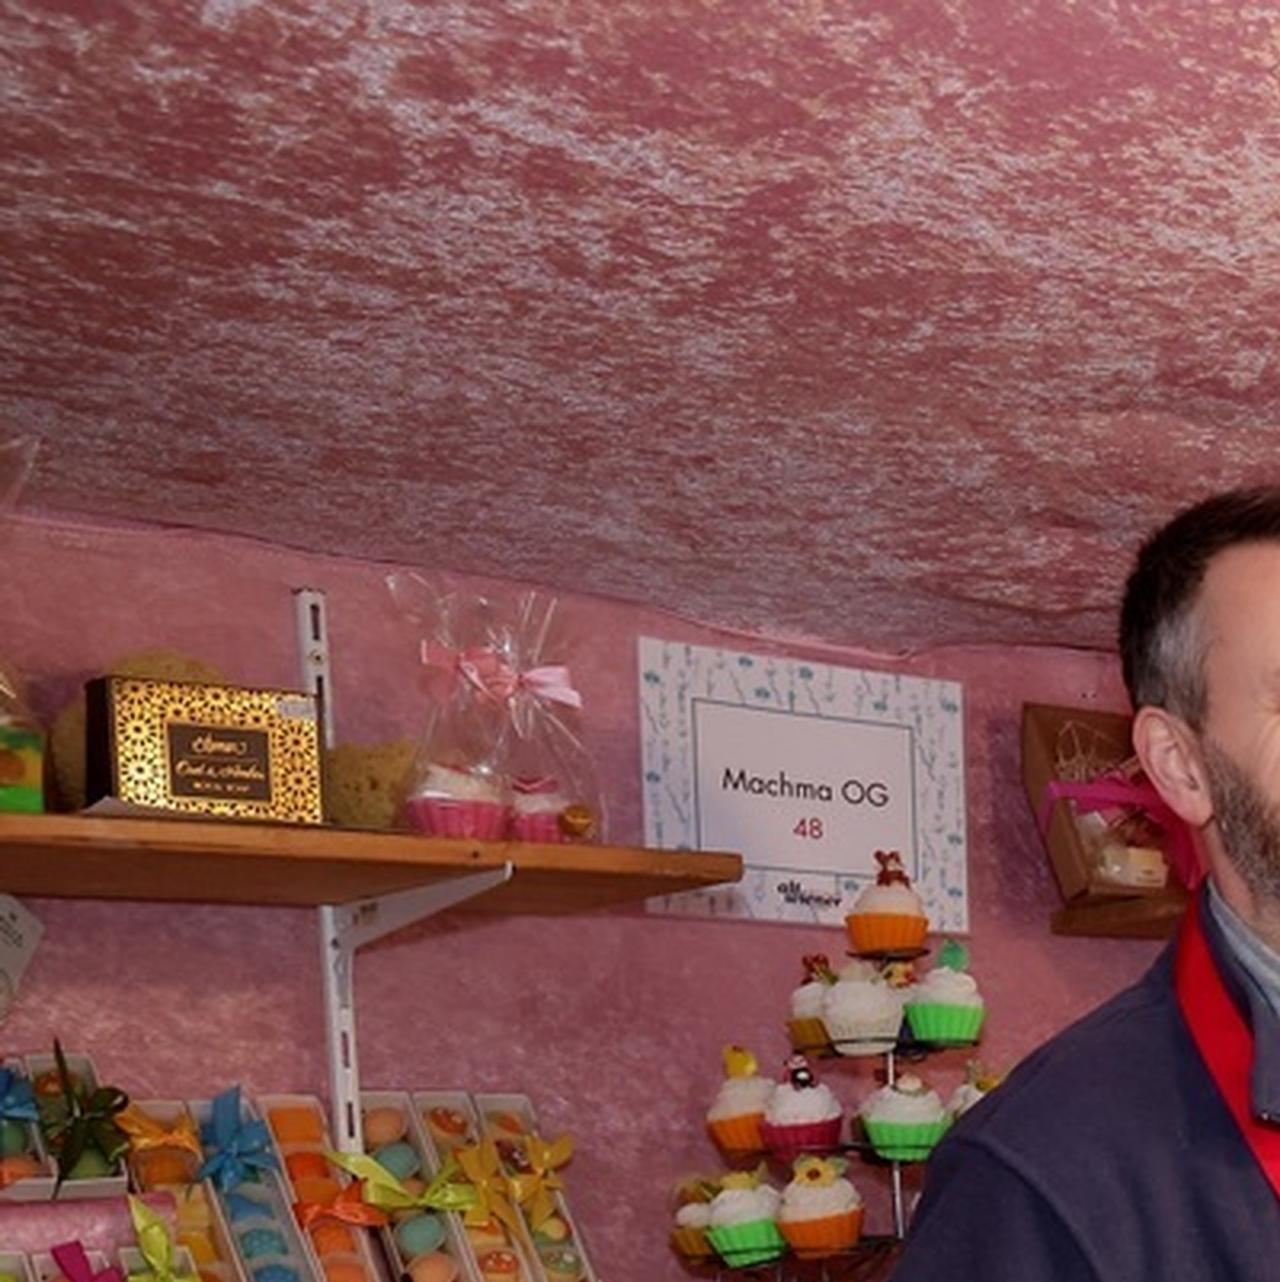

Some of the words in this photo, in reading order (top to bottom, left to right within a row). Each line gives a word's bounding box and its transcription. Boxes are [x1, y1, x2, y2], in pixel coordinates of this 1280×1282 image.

[722, 767, 833, 801] Machma
[841, 780, 890, 807] OG
[793, 817, 824, 839] 48
